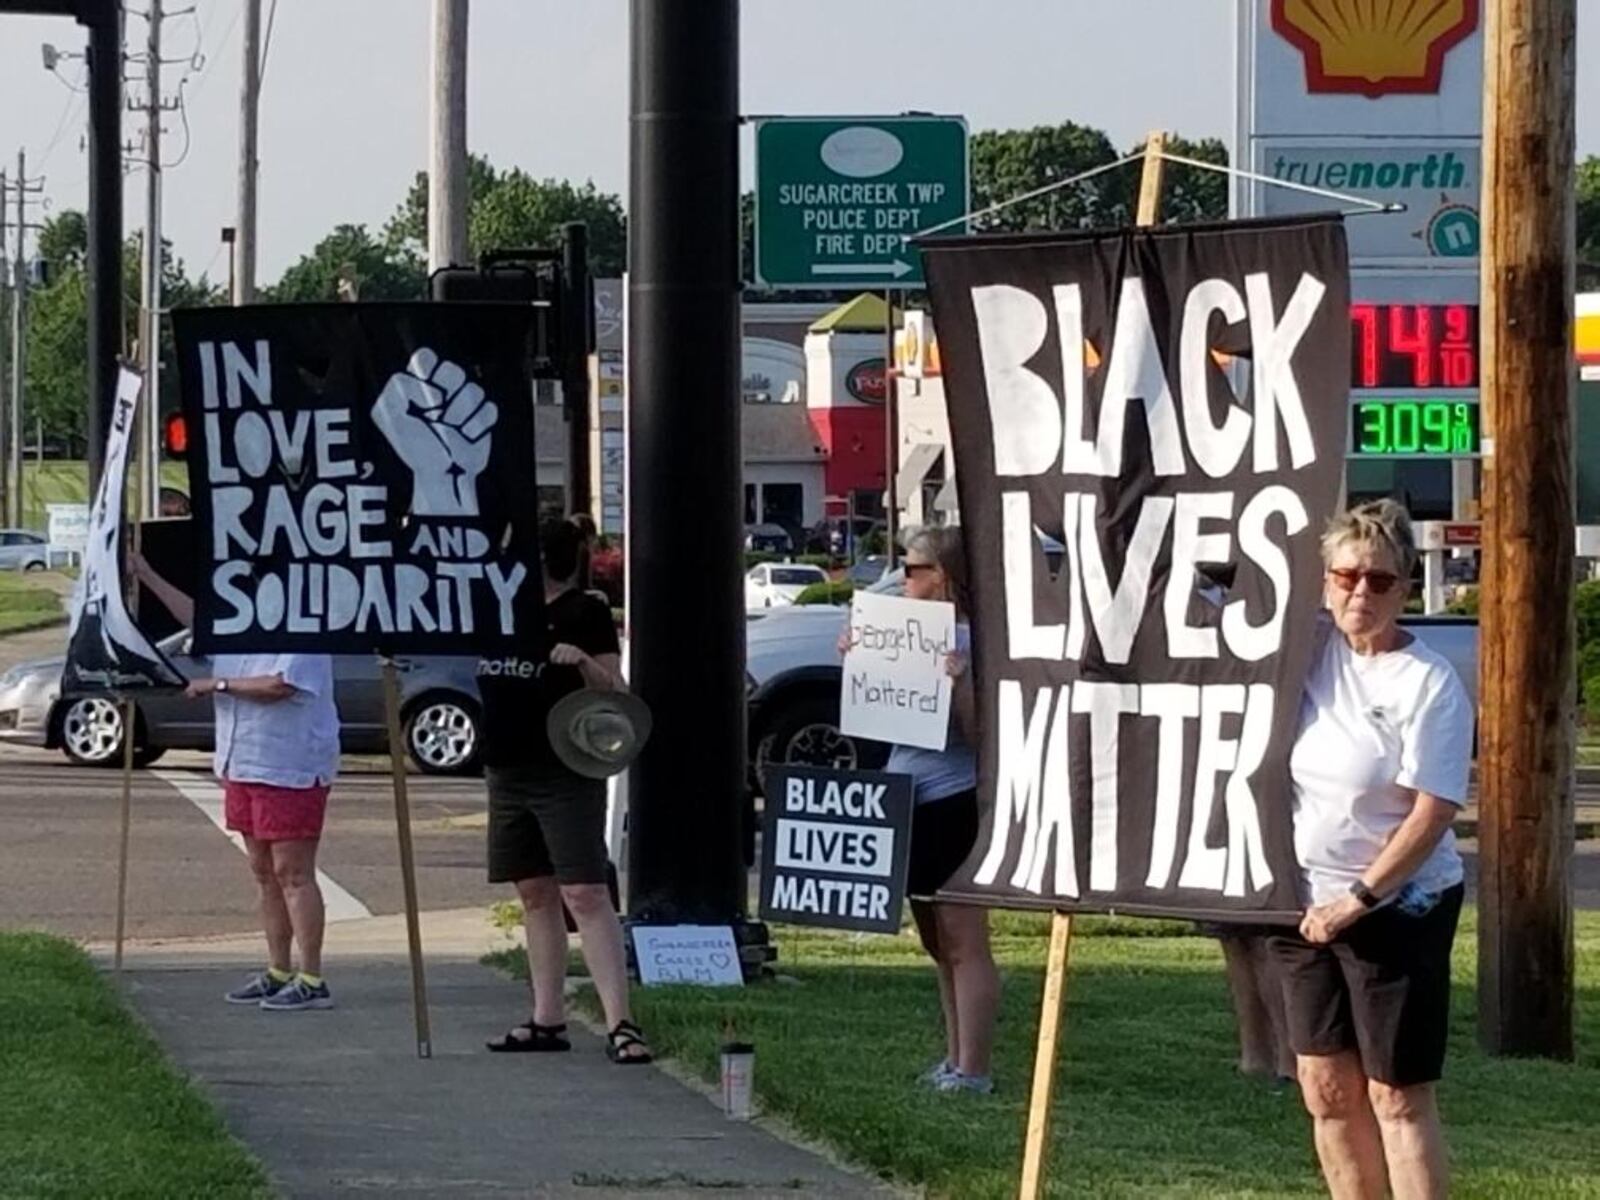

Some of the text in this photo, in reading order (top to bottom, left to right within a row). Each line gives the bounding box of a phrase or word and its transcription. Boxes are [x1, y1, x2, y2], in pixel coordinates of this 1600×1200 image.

[779, 183, 945, 204] SUGARCREEK TWP
[1274, 152, 1467, 188] truenorth
[803, 209, 920, 229] POLICE DEPT
[815, 234, 909, 255] FIRE DEPT
[199, 340, 273, 409] IN
[970, 272, 1326, 478] BLACK
[204, 408, 375, 484] LOVE,
[211, 483, 491, 560] RAGE AND
[212, 560, 528, 636] SOLIDARITY
[1002, 486, 1308, 664] LIVES
[906, 618, 950, 667] Floyd
[852, 672, 940, 713] Mattered
[786, 777, 888, 819] BLACK
[974, 679, 1275, 898] MATTER
[789, 827, 878, 868] LIVES
[771, 875, 891, 921] MATTER
